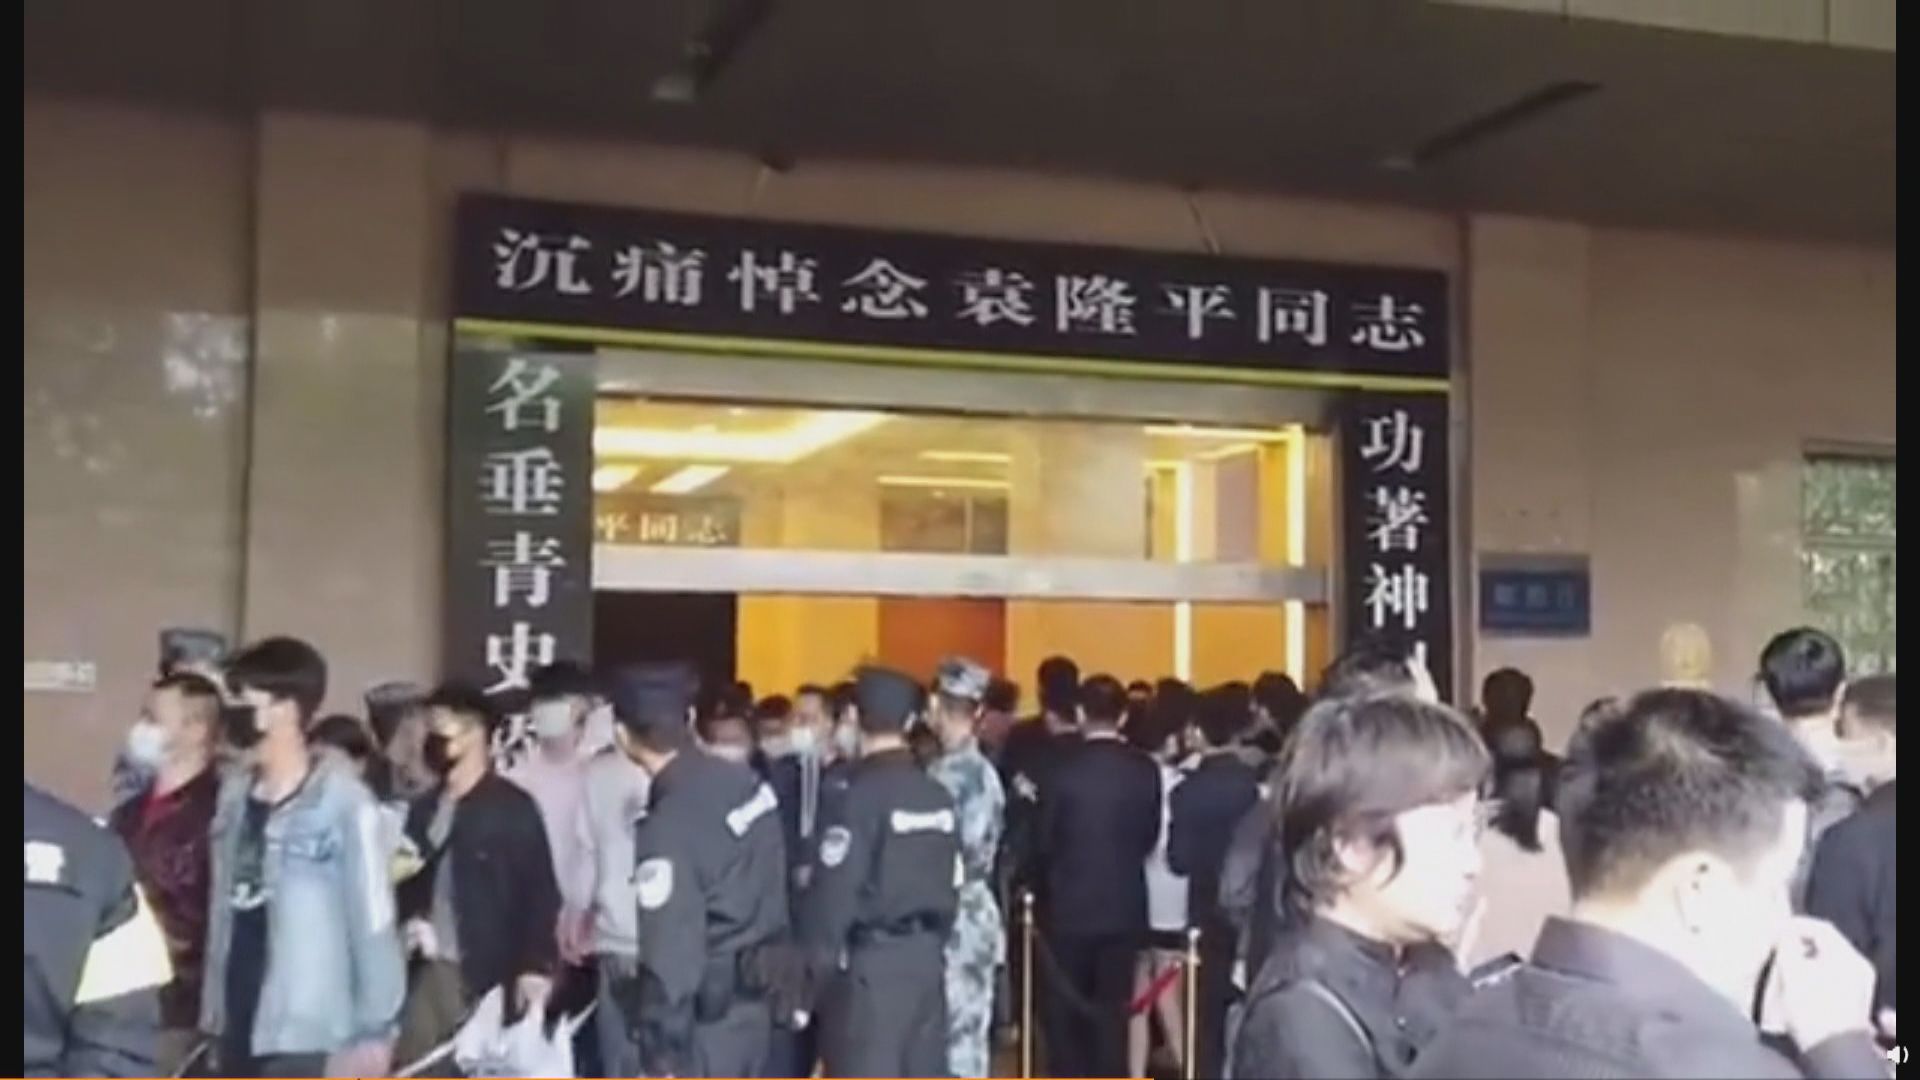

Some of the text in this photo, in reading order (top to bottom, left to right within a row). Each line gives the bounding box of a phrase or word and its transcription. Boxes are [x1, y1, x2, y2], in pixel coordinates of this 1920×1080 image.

[494, 228, 1426, 350] 沉痛悼念袁隆平同志
[1359, 410, 1438, 700] 功著神
